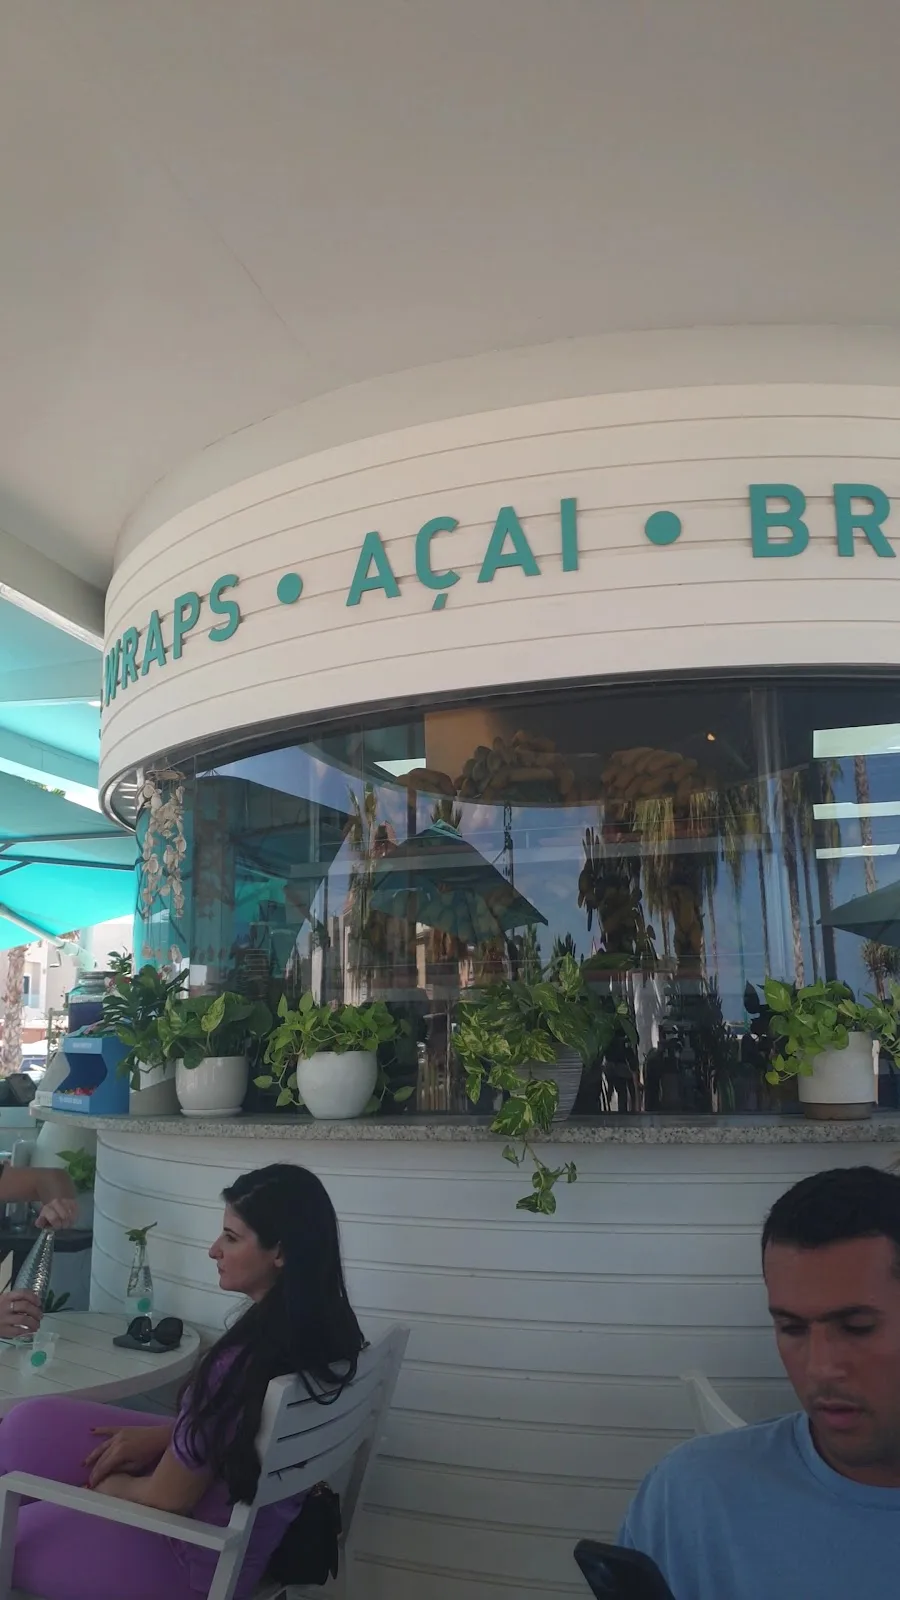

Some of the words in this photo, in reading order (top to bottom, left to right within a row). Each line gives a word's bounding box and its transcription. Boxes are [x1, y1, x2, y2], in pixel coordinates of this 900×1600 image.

[105, 574, 240, 707] WRAPS
[347, 499, 579, 611] AÇAI
[749, 483, 897, 558] BR
